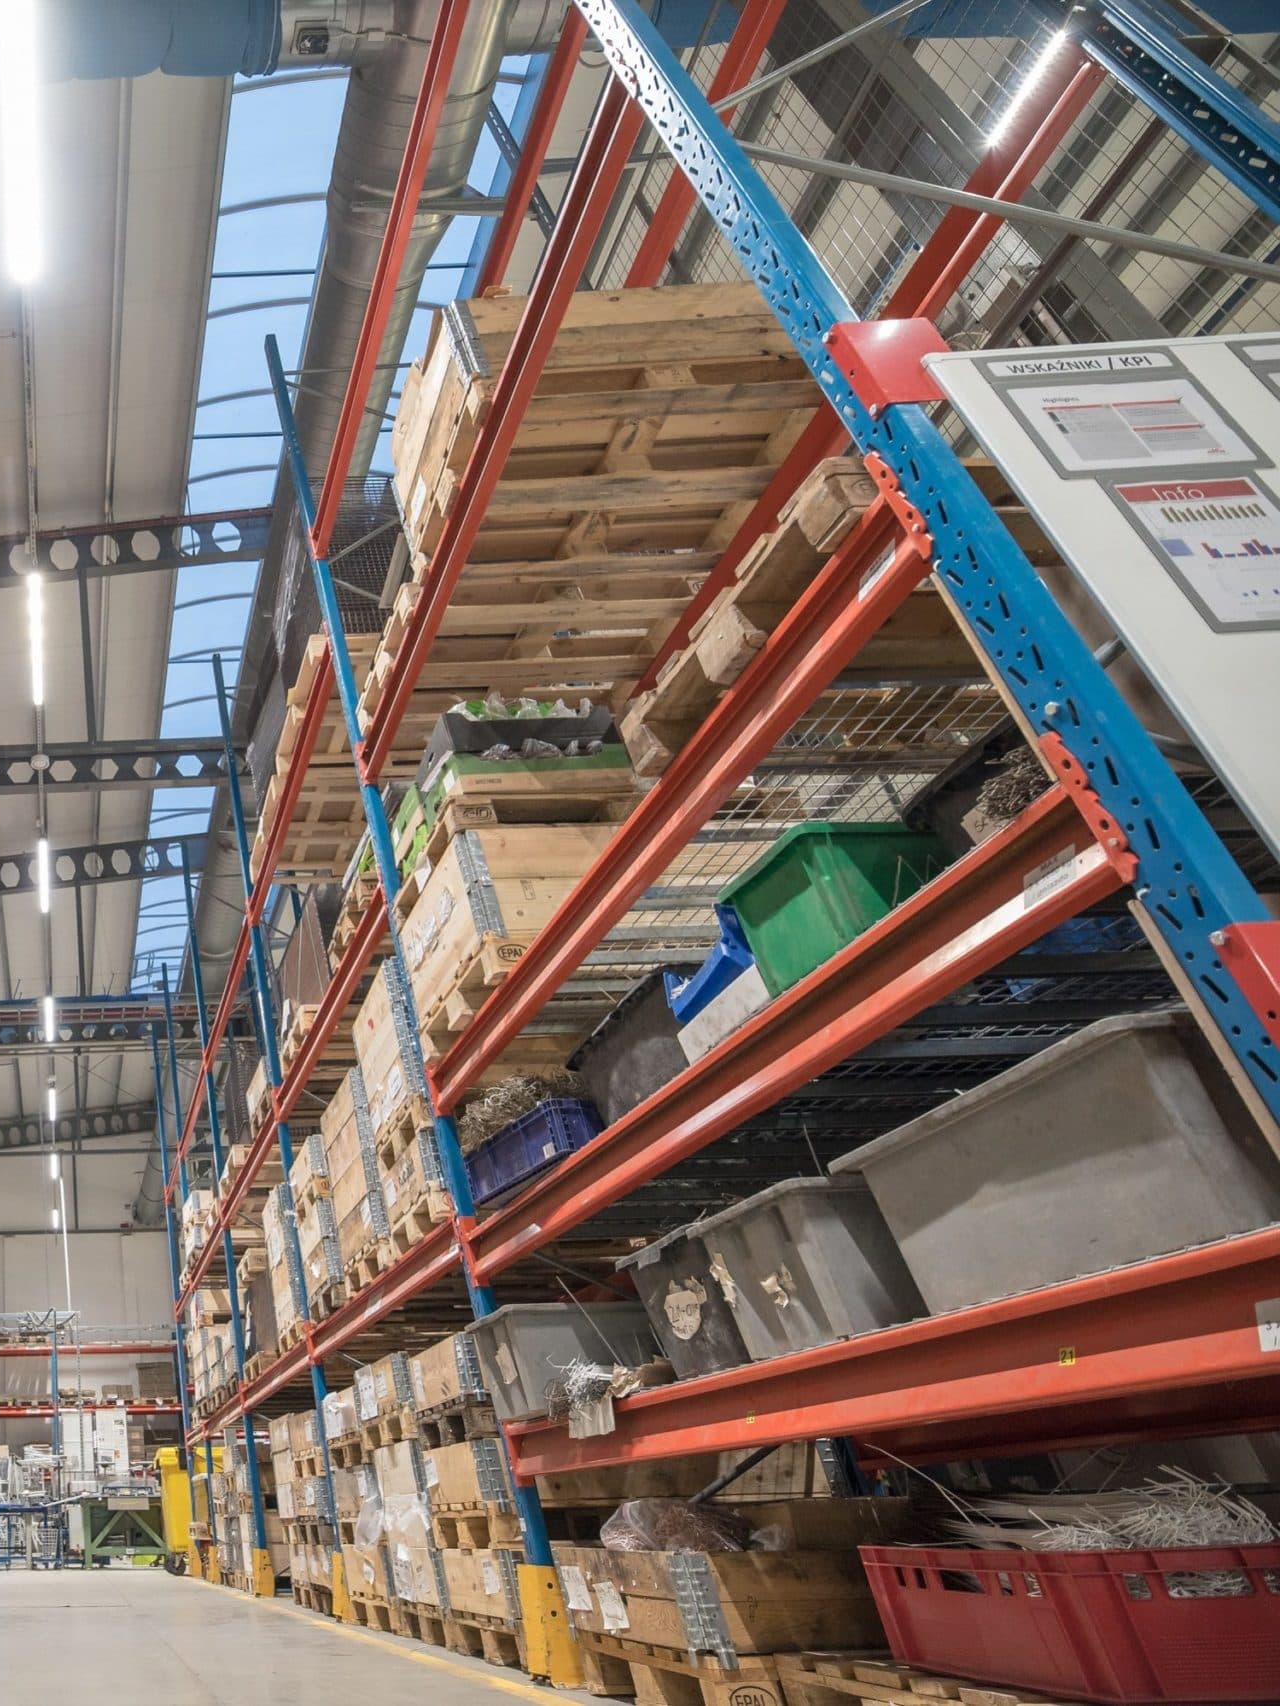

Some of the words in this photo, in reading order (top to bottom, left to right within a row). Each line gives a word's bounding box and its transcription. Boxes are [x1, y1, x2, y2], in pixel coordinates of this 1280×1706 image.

[1007, 359, 1103, 375] WSKAŹNIKI
[1107, 356, 1115, 371] /
[1120, 355, 1153, 368] KPI
[1152, 485, 1205, 502] Info
[1060, 1350, 1074, 1364] 21
